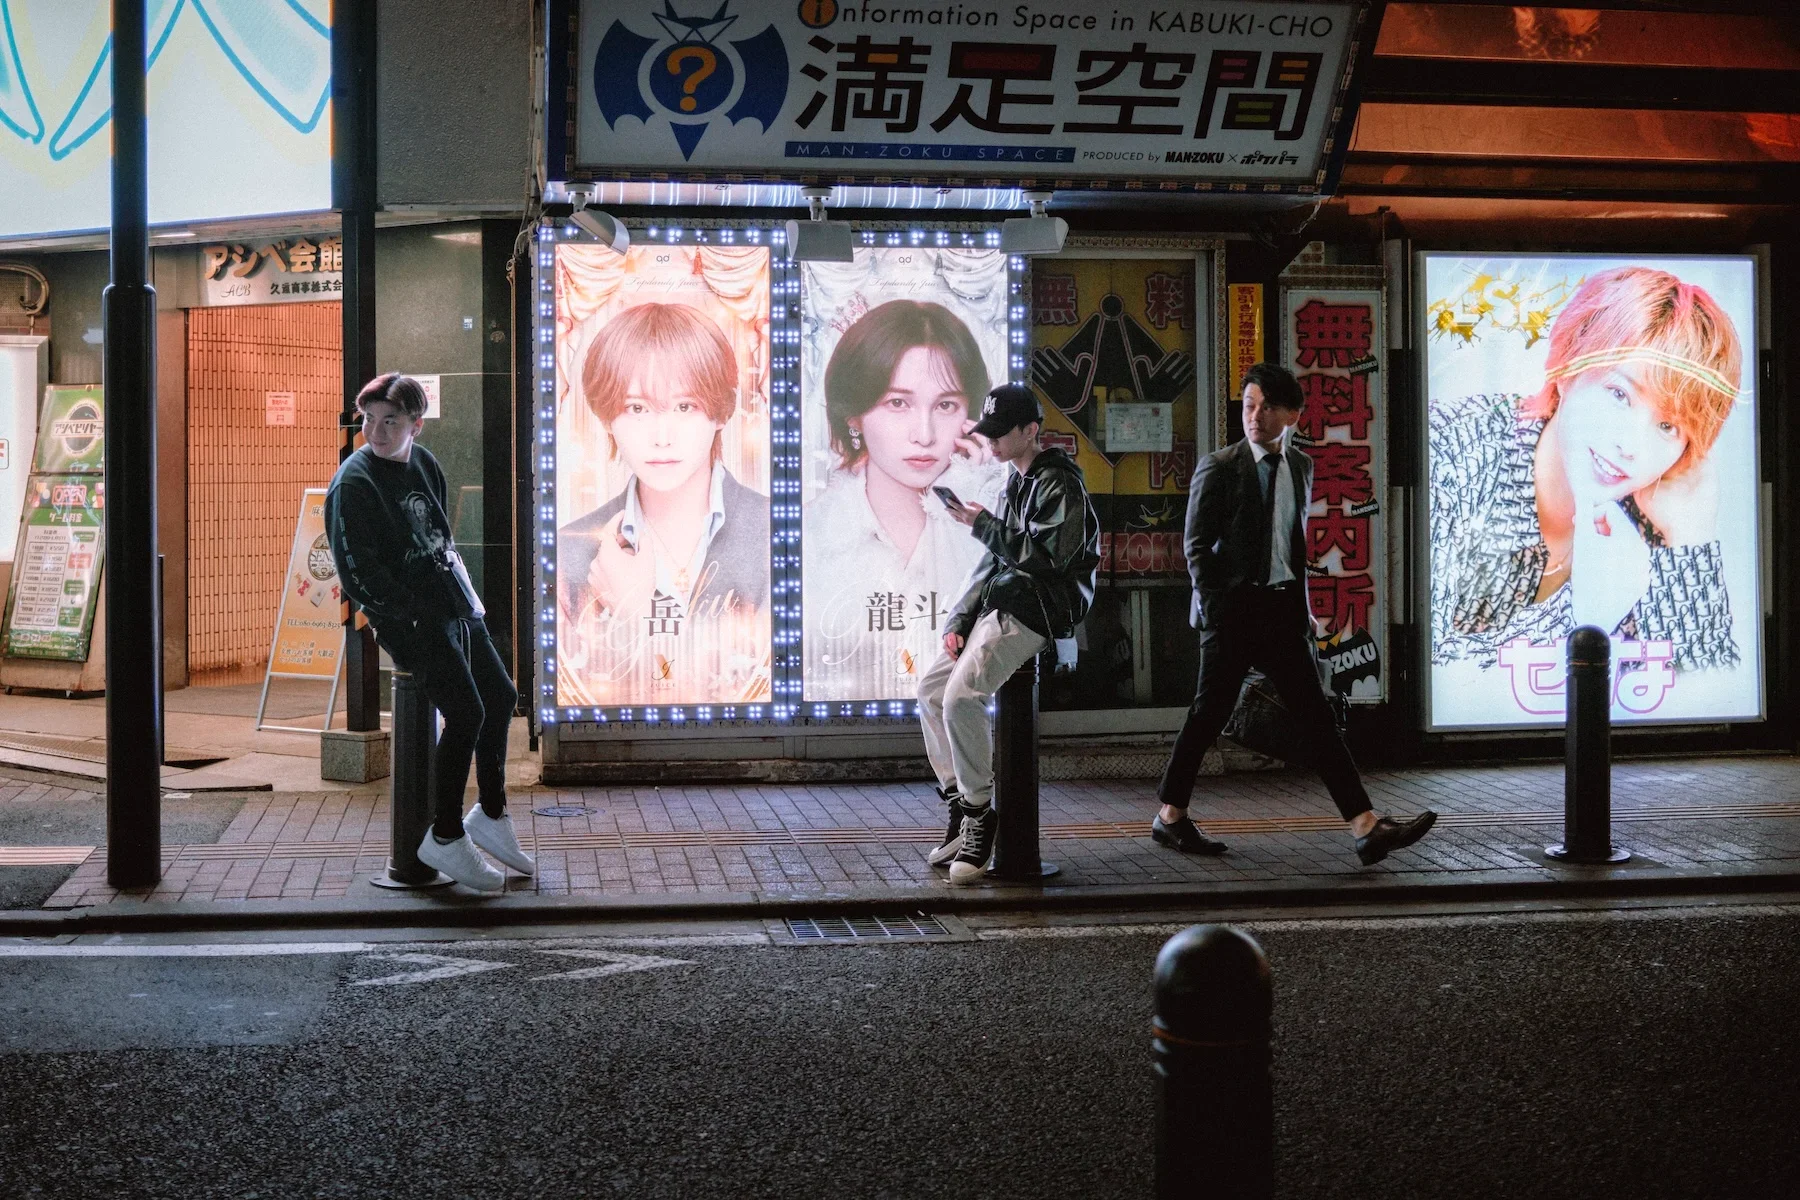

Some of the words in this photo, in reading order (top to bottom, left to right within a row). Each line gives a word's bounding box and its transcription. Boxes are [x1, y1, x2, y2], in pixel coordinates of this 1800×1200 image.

[1013, 6, 1097, 34] Space
[1111, 10, 1134, 31] in
[1148, 10, 1333, 38] KABUKI-CHO
[795, 35, 1324, 141] 満足空間
[796, 145, 952, 158] MAN-ZOKU
[977, 148, 1065, 161] SPACE
[1082, 151, 1144, 161] PRODUCED
[1148, 151, 1161, 164] by
[203, 236, 342, 280] アシベ会館
[54, 422, 104, 435] アシベビリヤー
[1296, 301, 1374, 635] 無料案内所
[55, 487, 85, 504] OPEN
[643, 588, 685, 637] 岳
[865, 591, 949, 633] 龍斗
